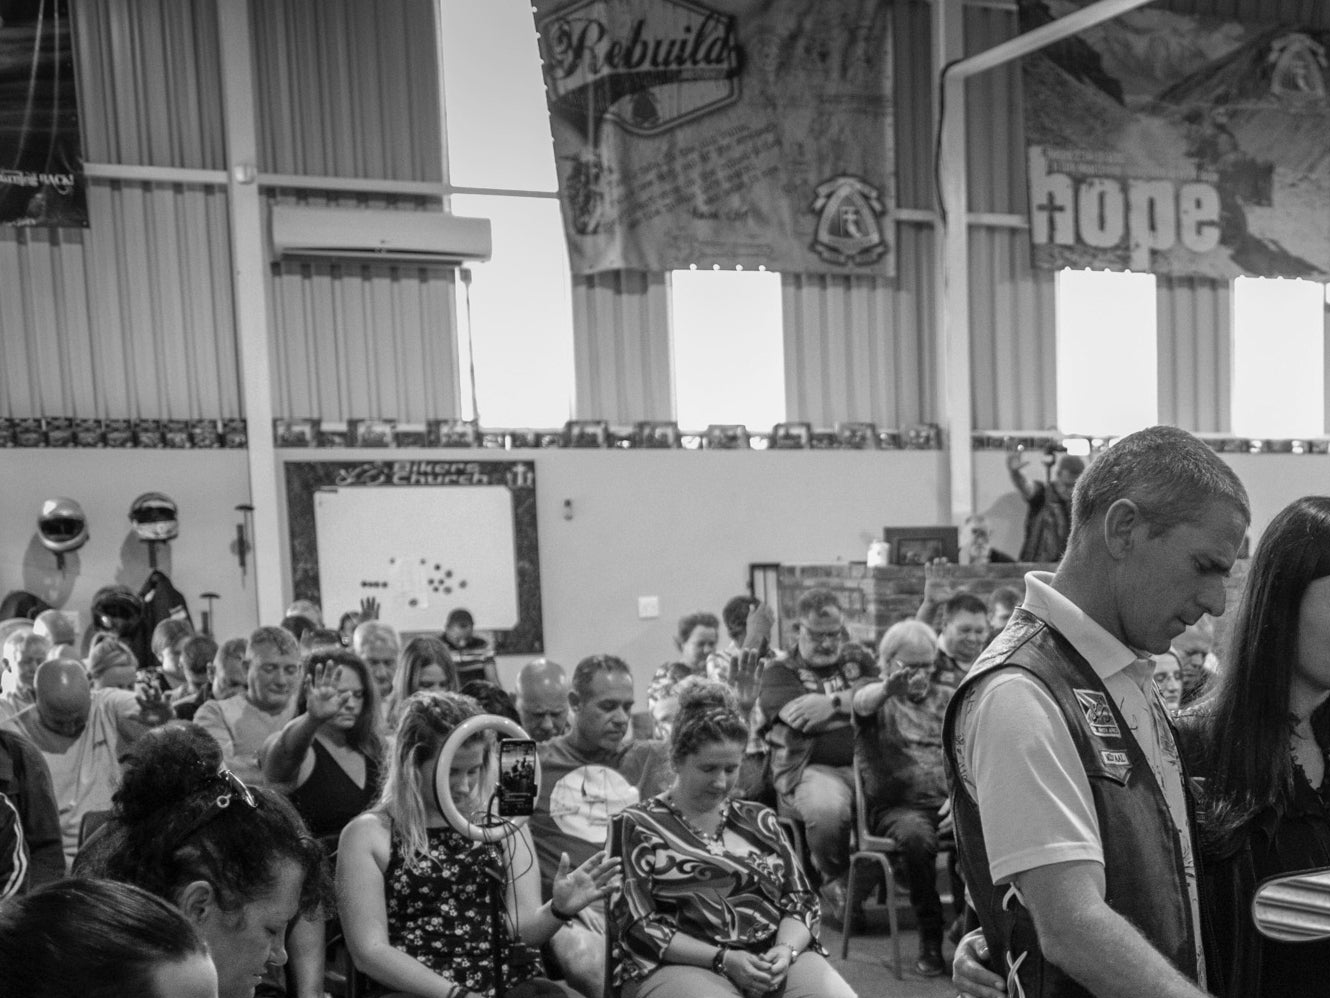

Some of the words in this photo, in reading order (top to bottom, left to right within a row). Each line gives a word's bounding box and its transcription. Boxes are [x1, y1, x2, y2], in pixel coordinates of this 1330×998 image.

[551, 14, 733, 80] Rebuild
[1027, 145, 1223, 272] hope
[392, 473, 490, 485] Church
[393, 461, 481, 474] Bikers
